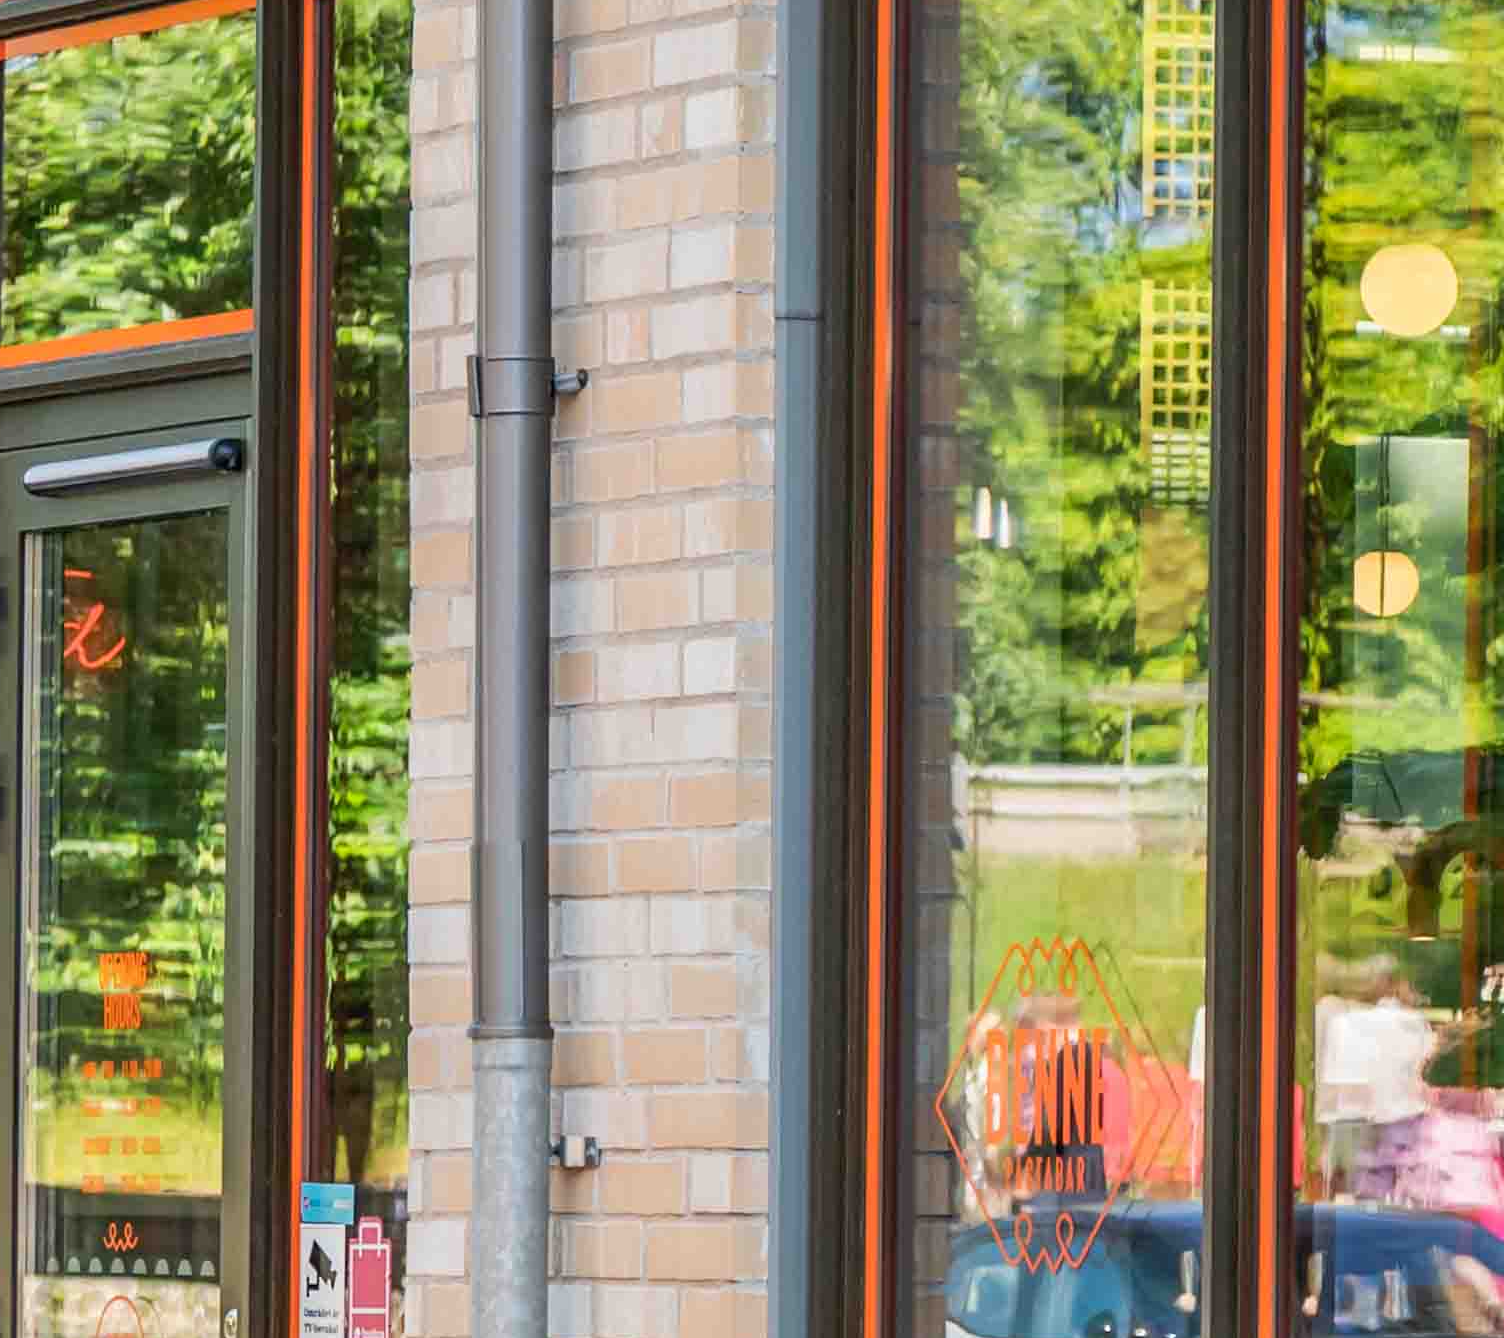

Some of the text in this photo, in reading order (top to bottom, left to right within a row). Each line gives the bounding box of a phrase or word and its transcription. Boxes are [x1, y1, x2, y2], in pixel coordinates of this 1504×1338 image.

[103, 994, 141, 1029] HOURS
[986, 1029, 1109, 1146] BENNE
[1004, 1156, 1088, 1193] PASTABAR
